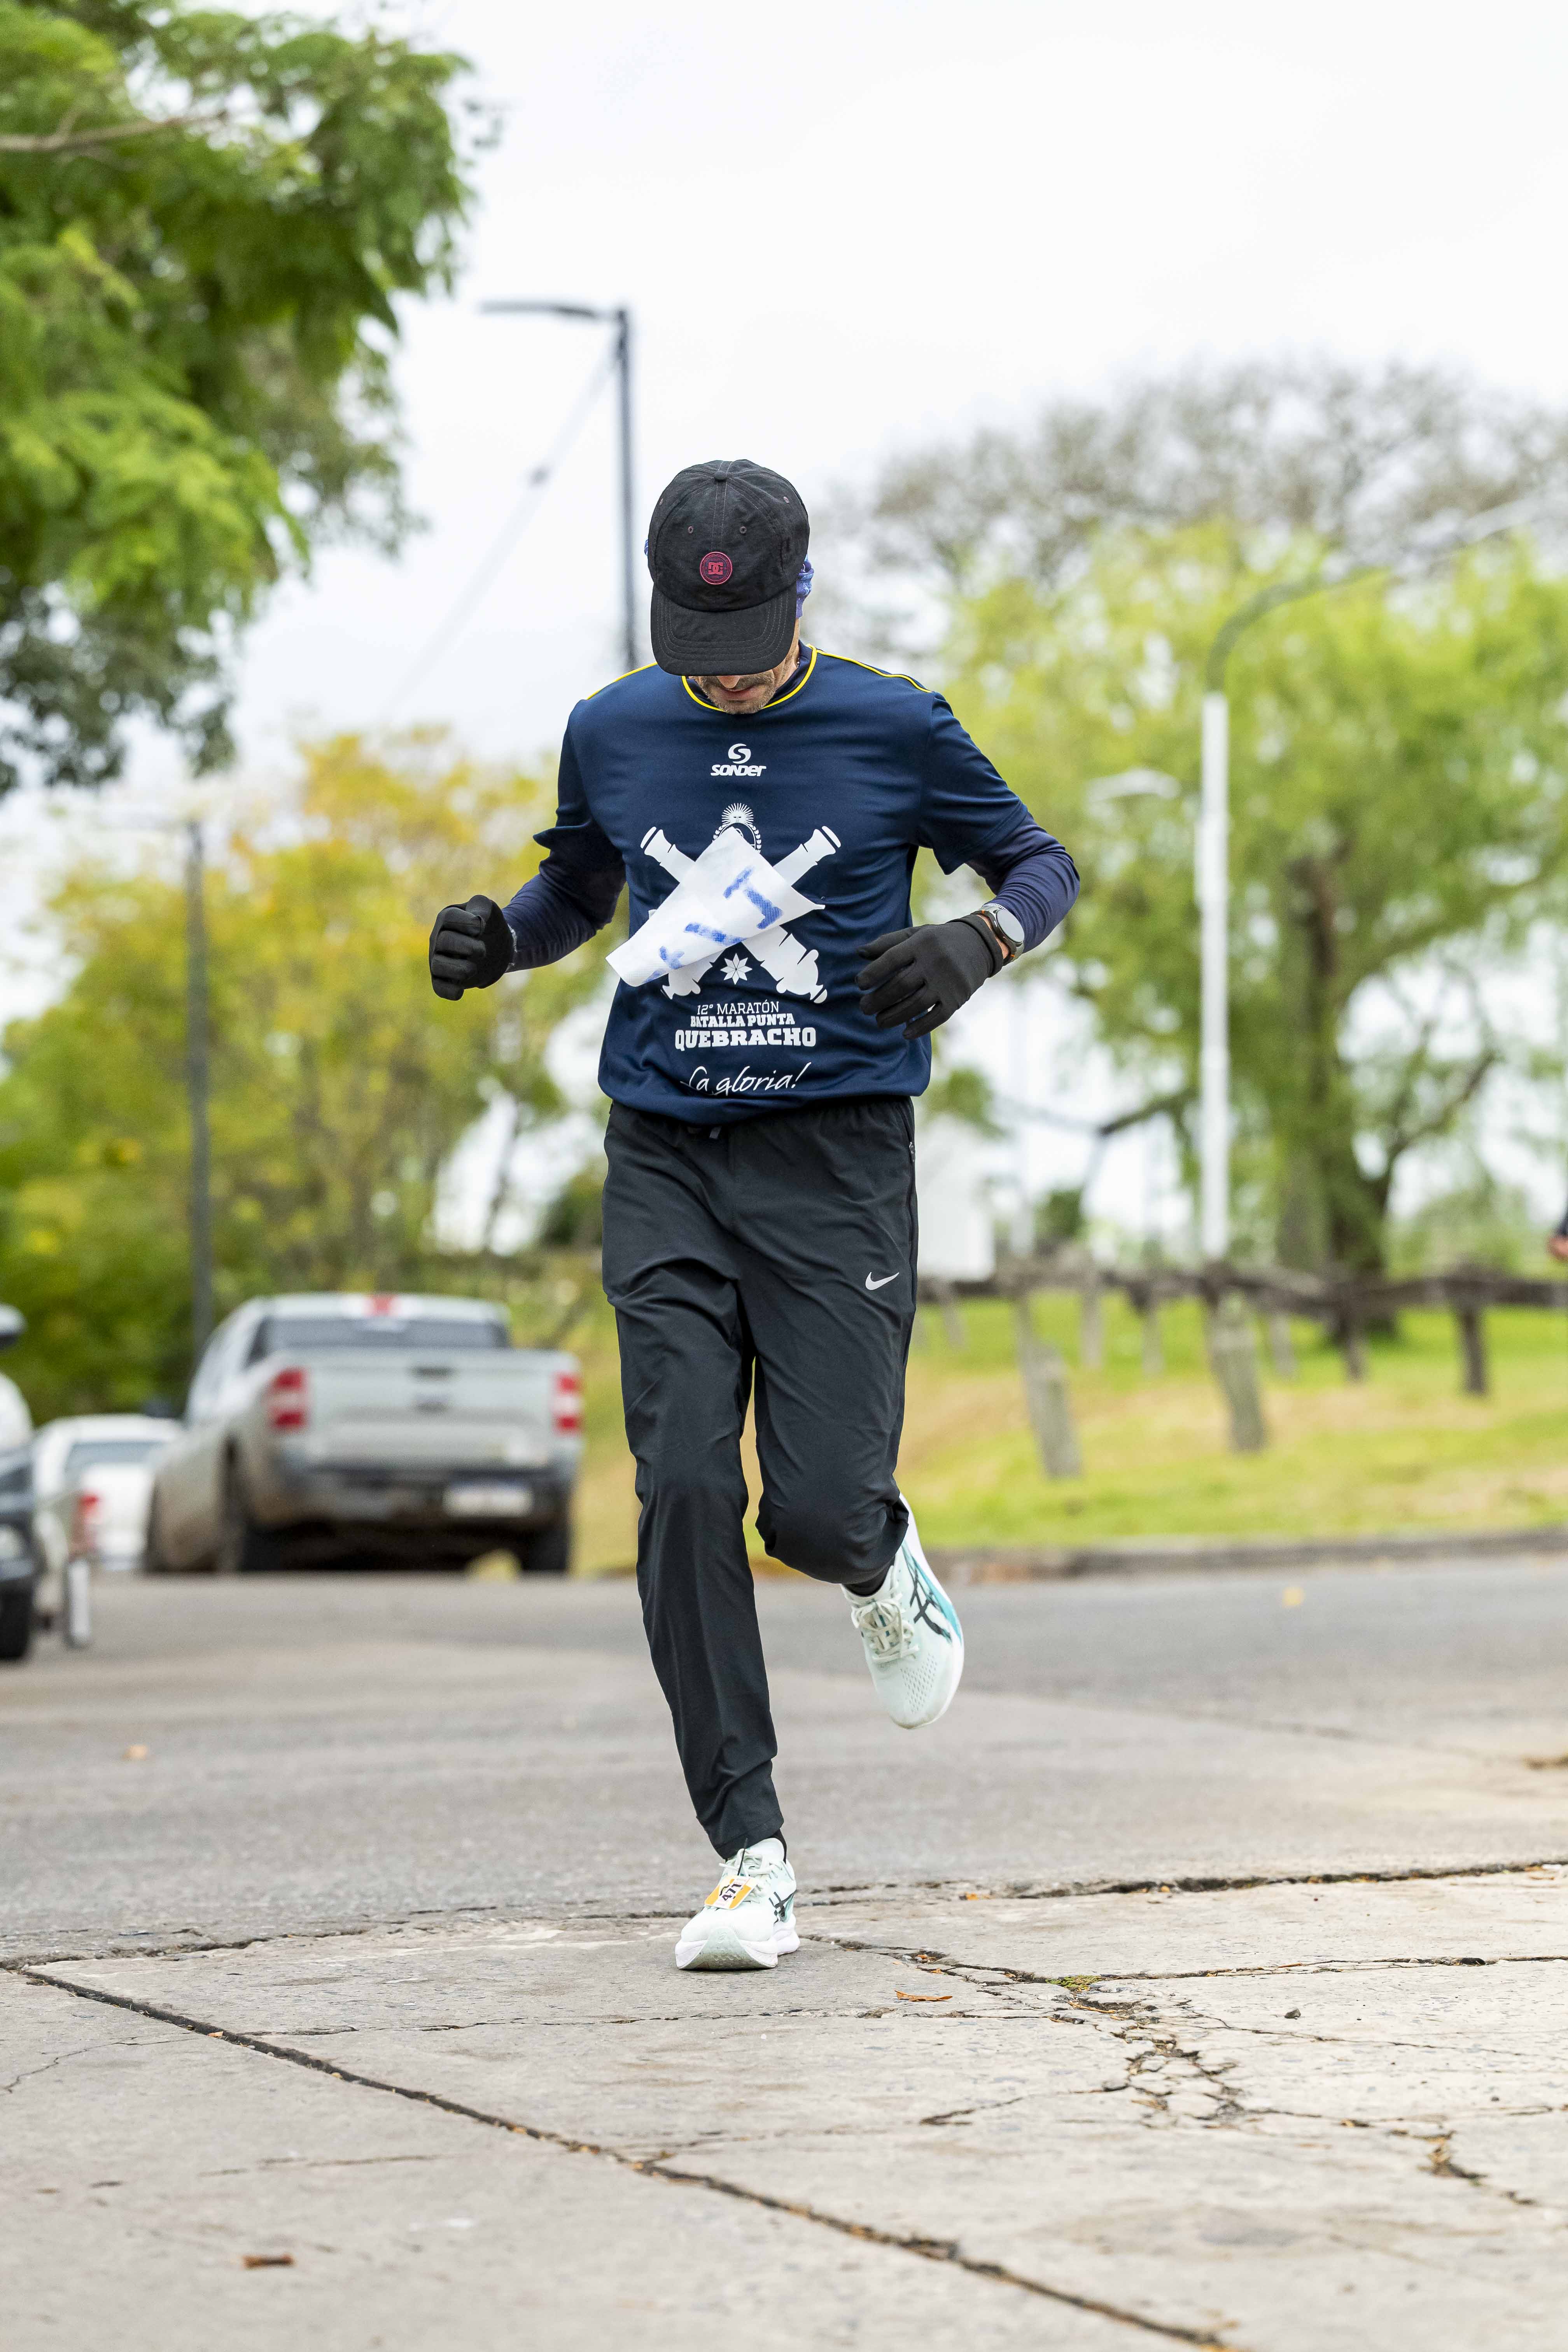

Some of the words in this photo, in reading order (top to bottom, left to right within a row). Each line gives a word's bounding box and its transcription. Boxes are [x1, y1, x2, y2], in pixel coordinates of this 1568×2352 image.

[717, 999, 779, 1015] MARATÓN
[690, 1015, 746, 1027] BATALLA
[747, 1013, 795, 1027] PUNTA
[675, 1027, 816, 1051] QUEBRACHO
